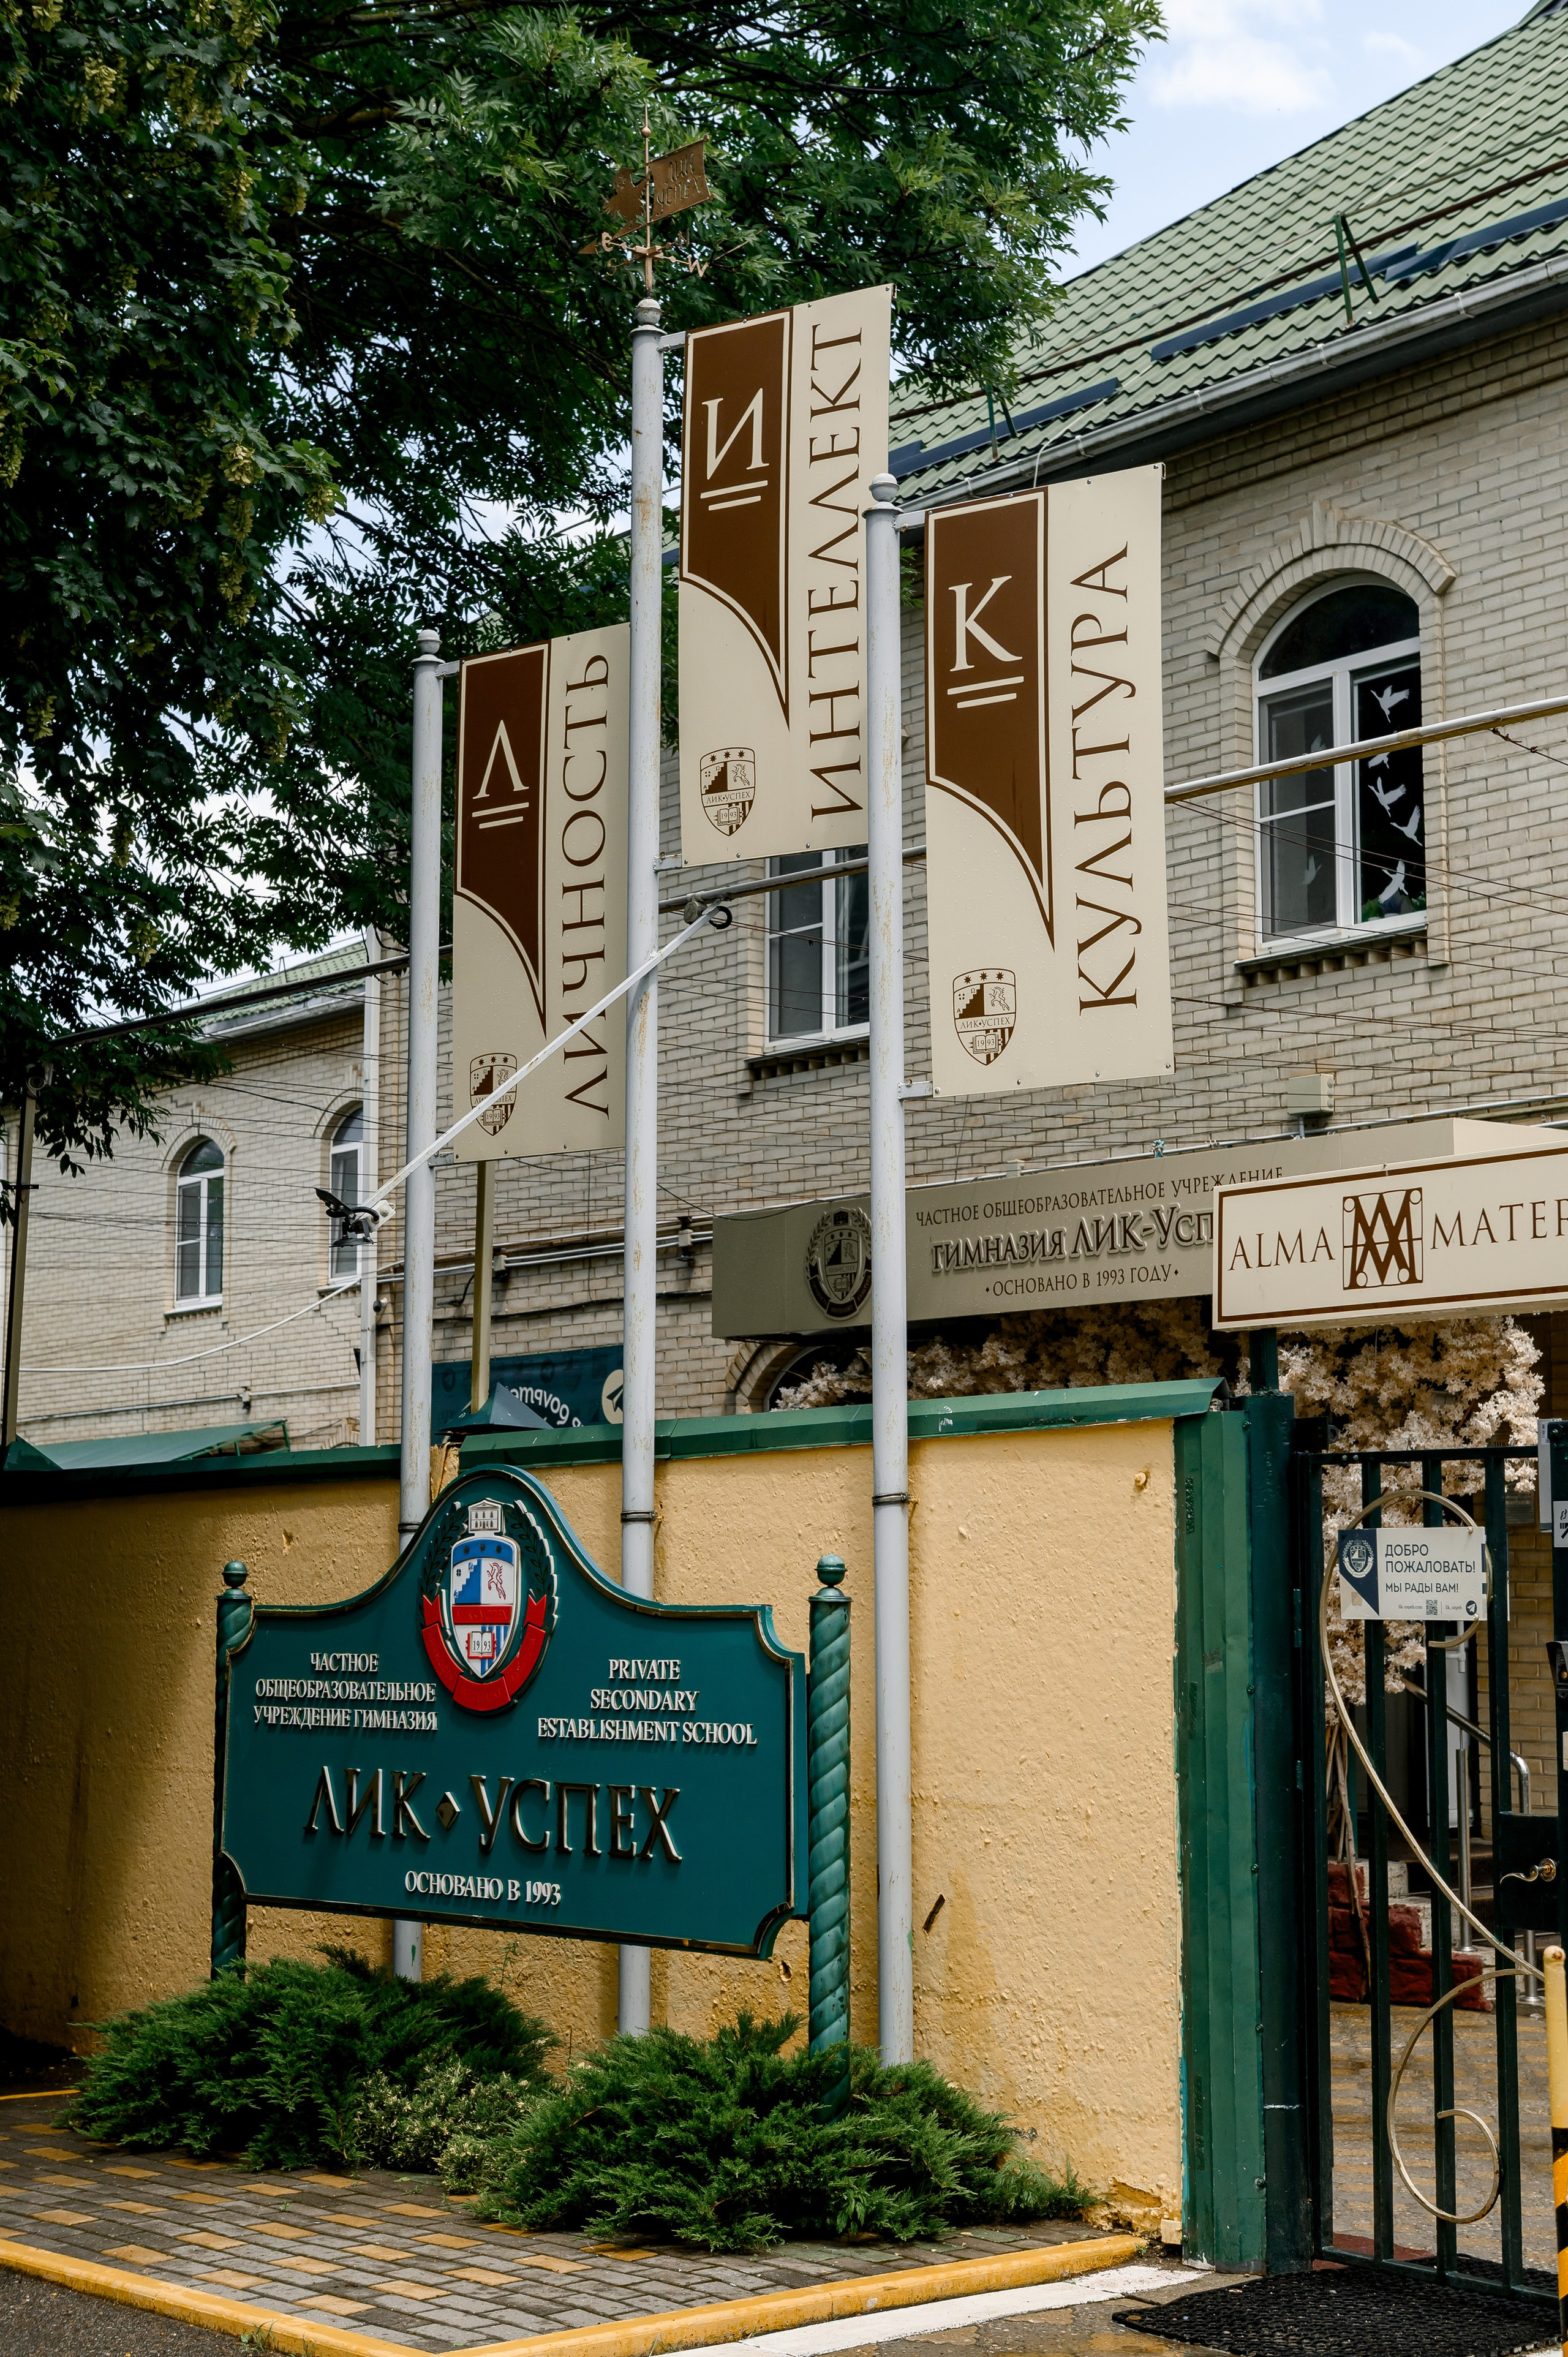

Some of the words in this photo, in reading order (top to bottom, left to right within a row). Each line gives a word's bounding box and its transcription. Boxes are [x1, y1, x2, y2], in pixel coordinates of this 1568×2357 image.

[701, 387, 769, 481] И
[807, 323, 863, 822] ИНТЕЛЛЕКТ
[948, 575, 1023, 673] К
[1070, 541, 1142, 1016] КУЛЬТУРА
[562, 654, 609, 1120] ЛИЧНОСТЬ
[916, 1205, 979, 1226] ЧАСТНОЕ
[983, 1182, 1165, 1218] ОБЩЕОБРАЗОВАТЕЛЬНОЕ
[932, 1228, 1065, 1270] ГИМНАЗИЯ
[1070, 1205, 1213, 1254] ЛИК-УСП
[1227, 1226, 1336, 1272] ALMA
[993, 1274, 1077, 1297] ОСНОВАНО
[1082, 1273, 1090, 1288] В
[1096, 1269, 1125, 1287] 1993
[1130, 1264, 1172, 1283] ГОДУ
[1385, 1544, 1429, 1558] ДОБРО
[1385, 1561, 1476, 1573] ПОЖАЛОВАТЬ!
[1385, 1583, 1402, 1593] МЫ
[1404, 1583, 1433, 1594] РАДЫ
[1436, 1583, 1459, 1593] ВАМ!
[311, 1653, 379, 1672] ЧАСТНОЕ
[608, 1659, 681, 1680] PRIVATE
[255, 1679, 437, 1702] ОБЩЕОБРАЗОВАТЕЛЬНОЕ
[590, 1689, 700, 1711] SECONDARY
[254, 1705, 352, 1729] УЧРЕЖДЕНИЕ
[353, 1709, 438, 1730] ГИМНАЗИЯ
[538, 1718, 680, 1741] ESTABLISHMENT
[682, 1722, 759, 1744] SCHOOL
[303, 1765, 431, 1839] ЛИК
[468, 1774, 682, 1861] УСПЕХ
[405, 1871, 503, 1900] ОСНОВАНО
[508, 1879, 521, 1901] В
[525, 1881, 562, 1906] 1993
